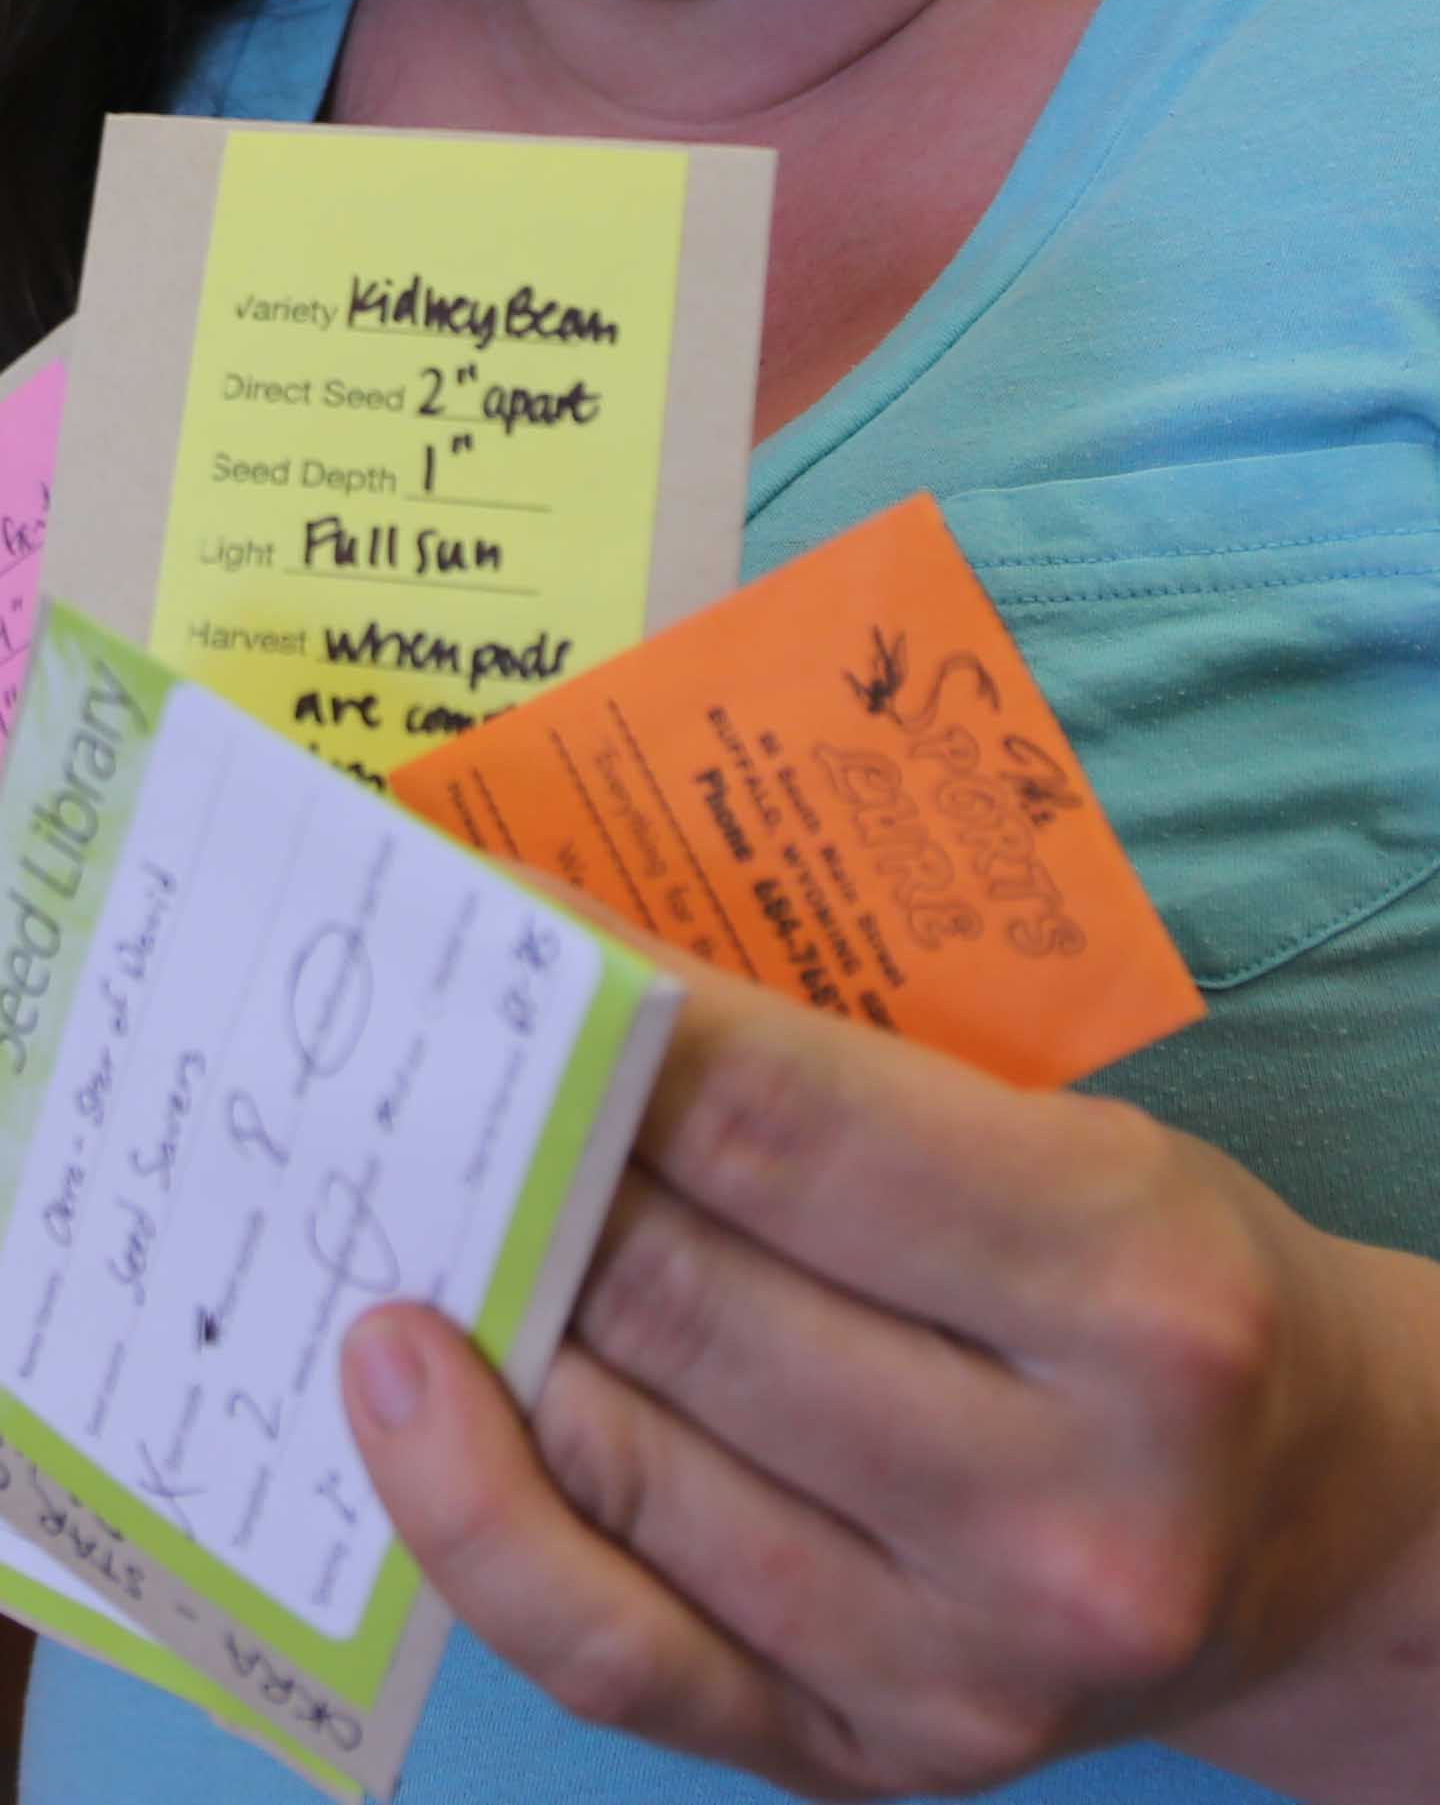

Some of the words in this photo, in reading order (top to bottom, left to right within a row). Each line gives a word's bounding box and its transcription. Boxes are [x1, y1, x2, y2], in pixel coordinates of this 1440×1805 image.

[233, 292, 340, 333] Variety
[221, 371, 315, 407] Direct
[320, 379, 407, 414] Seed
[479, 380, 599, 435] apart
[211, 450, 294, 488] Seed
[297, 458, 399, 498] Depth
[199, 538, 277, 575] Light
[301, 513, 399, 569] Full
[191, 620, 309, 659] Harvest
[292, 690, 381, 731] are
[20, 657, 156, 901] Library
[694, 766, 756, 866] Phone
[818, 843, 858, 905] Main
[781, 844, 862, 978] WYOMING
[37, 1498, 145, 1601] STAR
[224, 1634, 364, 1753] OKRA
